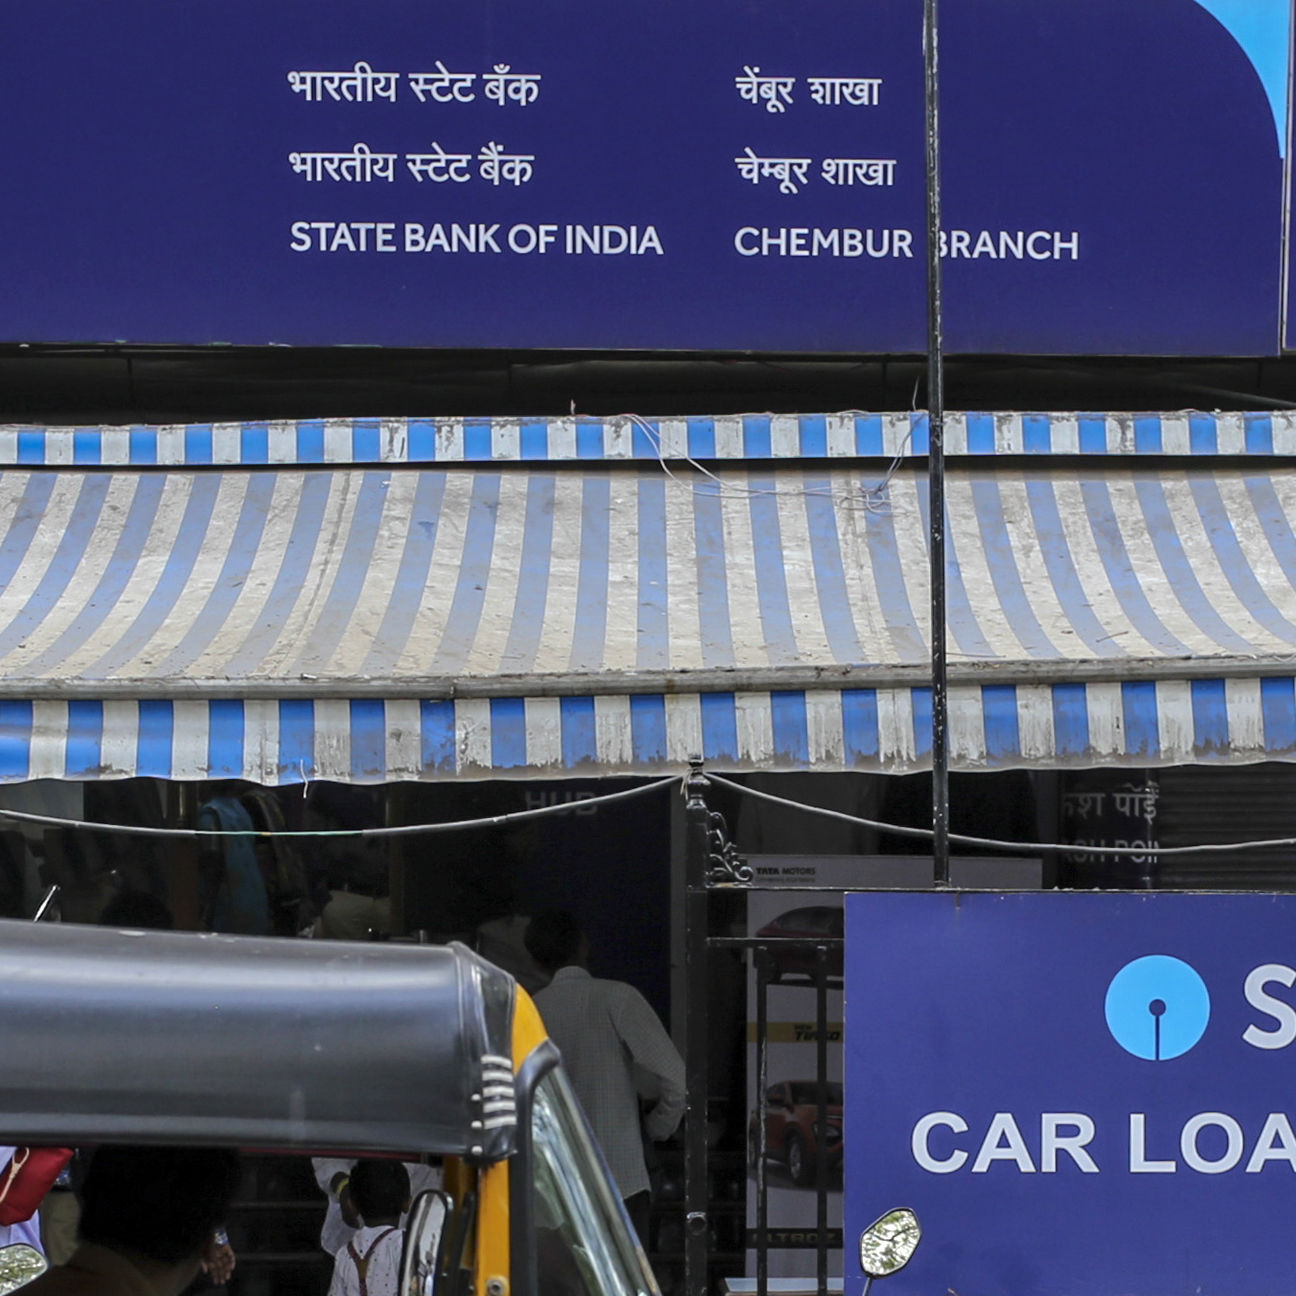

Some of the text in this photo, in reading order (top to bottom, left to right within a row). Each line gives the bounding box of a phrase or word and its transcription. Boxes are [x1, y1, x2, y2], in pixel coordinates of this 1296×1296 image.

[287, 61, 400, 102] भारतीय
[408, 60, 476, 102] स्टेट
[734, 65, 883, 113] चेंबूर शाखा
[288, 141, 535, 186] भारतीय स्टेट बैंक
[734, 146, 897, 194] चेम्बूर शाखा
[290, 221, 664, 255] STATE BANK OF INDIA
[734, 226, 913, 258] CHEMBUR
[911, 1111, 1100, 1174] CAR
